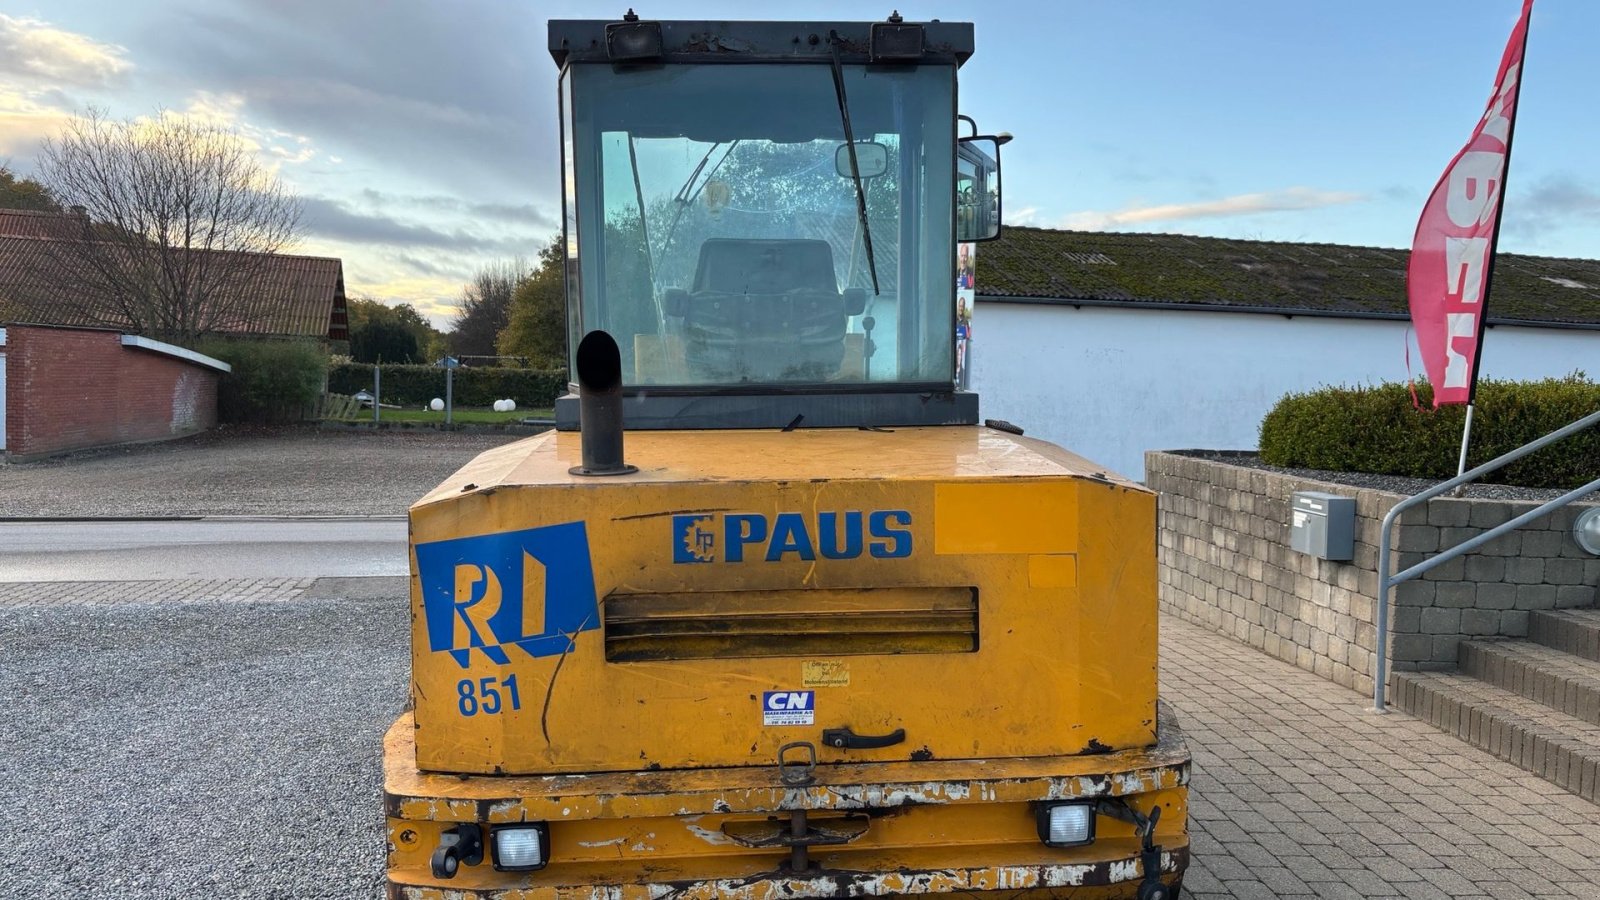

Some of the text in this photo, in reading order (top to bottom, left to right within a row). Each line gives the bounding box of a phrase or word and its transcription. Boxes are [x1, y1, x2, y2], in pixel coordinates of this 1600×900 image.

[724, 510, 913, 563] PAUS
[457, 673, 521, 717] 851
[768, 692, 809, 710] CN
